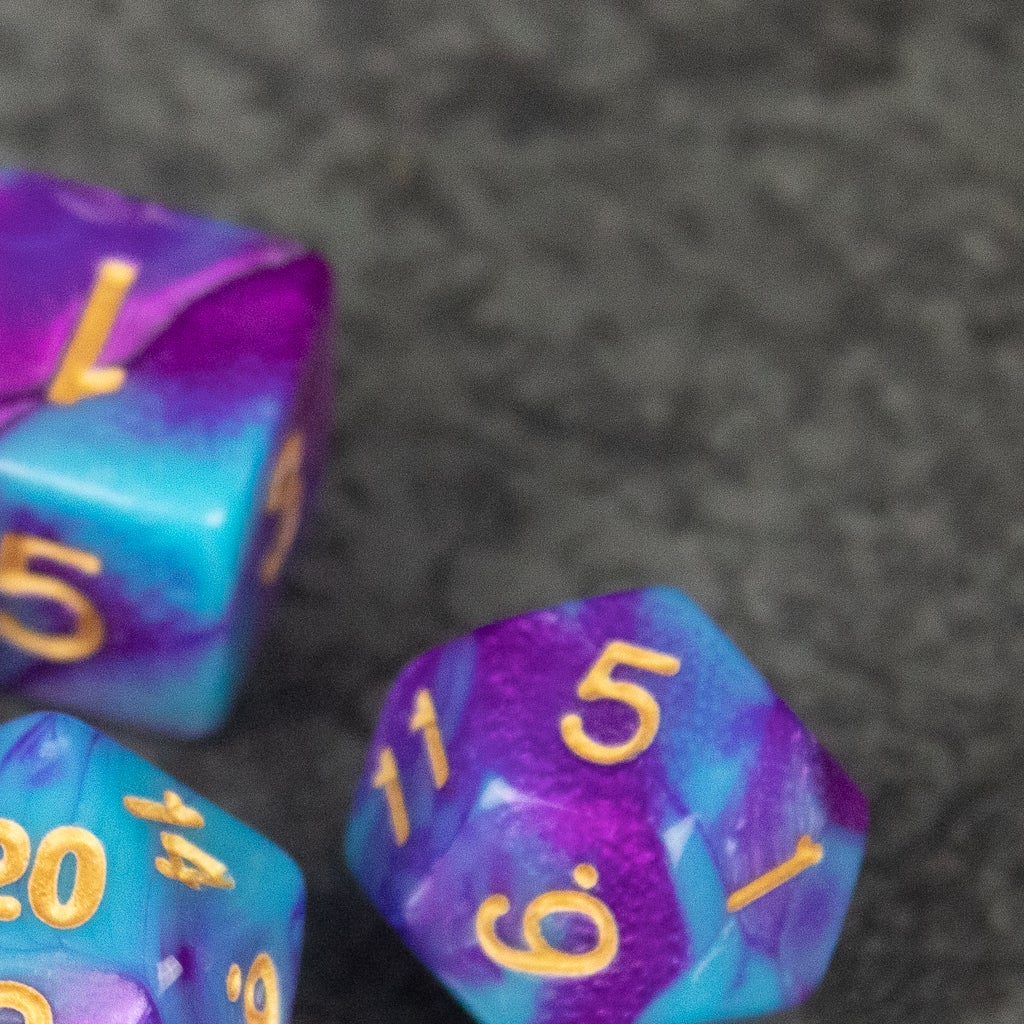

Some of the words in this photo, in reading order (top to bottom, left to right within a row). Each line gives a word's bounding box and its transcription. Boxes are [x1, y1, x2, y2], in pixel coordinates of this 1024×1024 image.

[47, 262, 139, 406] 1
[559, 639, 682, 766] 5
[373, 688, 449, 847] 11
[122, 789, 236, 891] 14
[726, 833, 824, 913] 1
